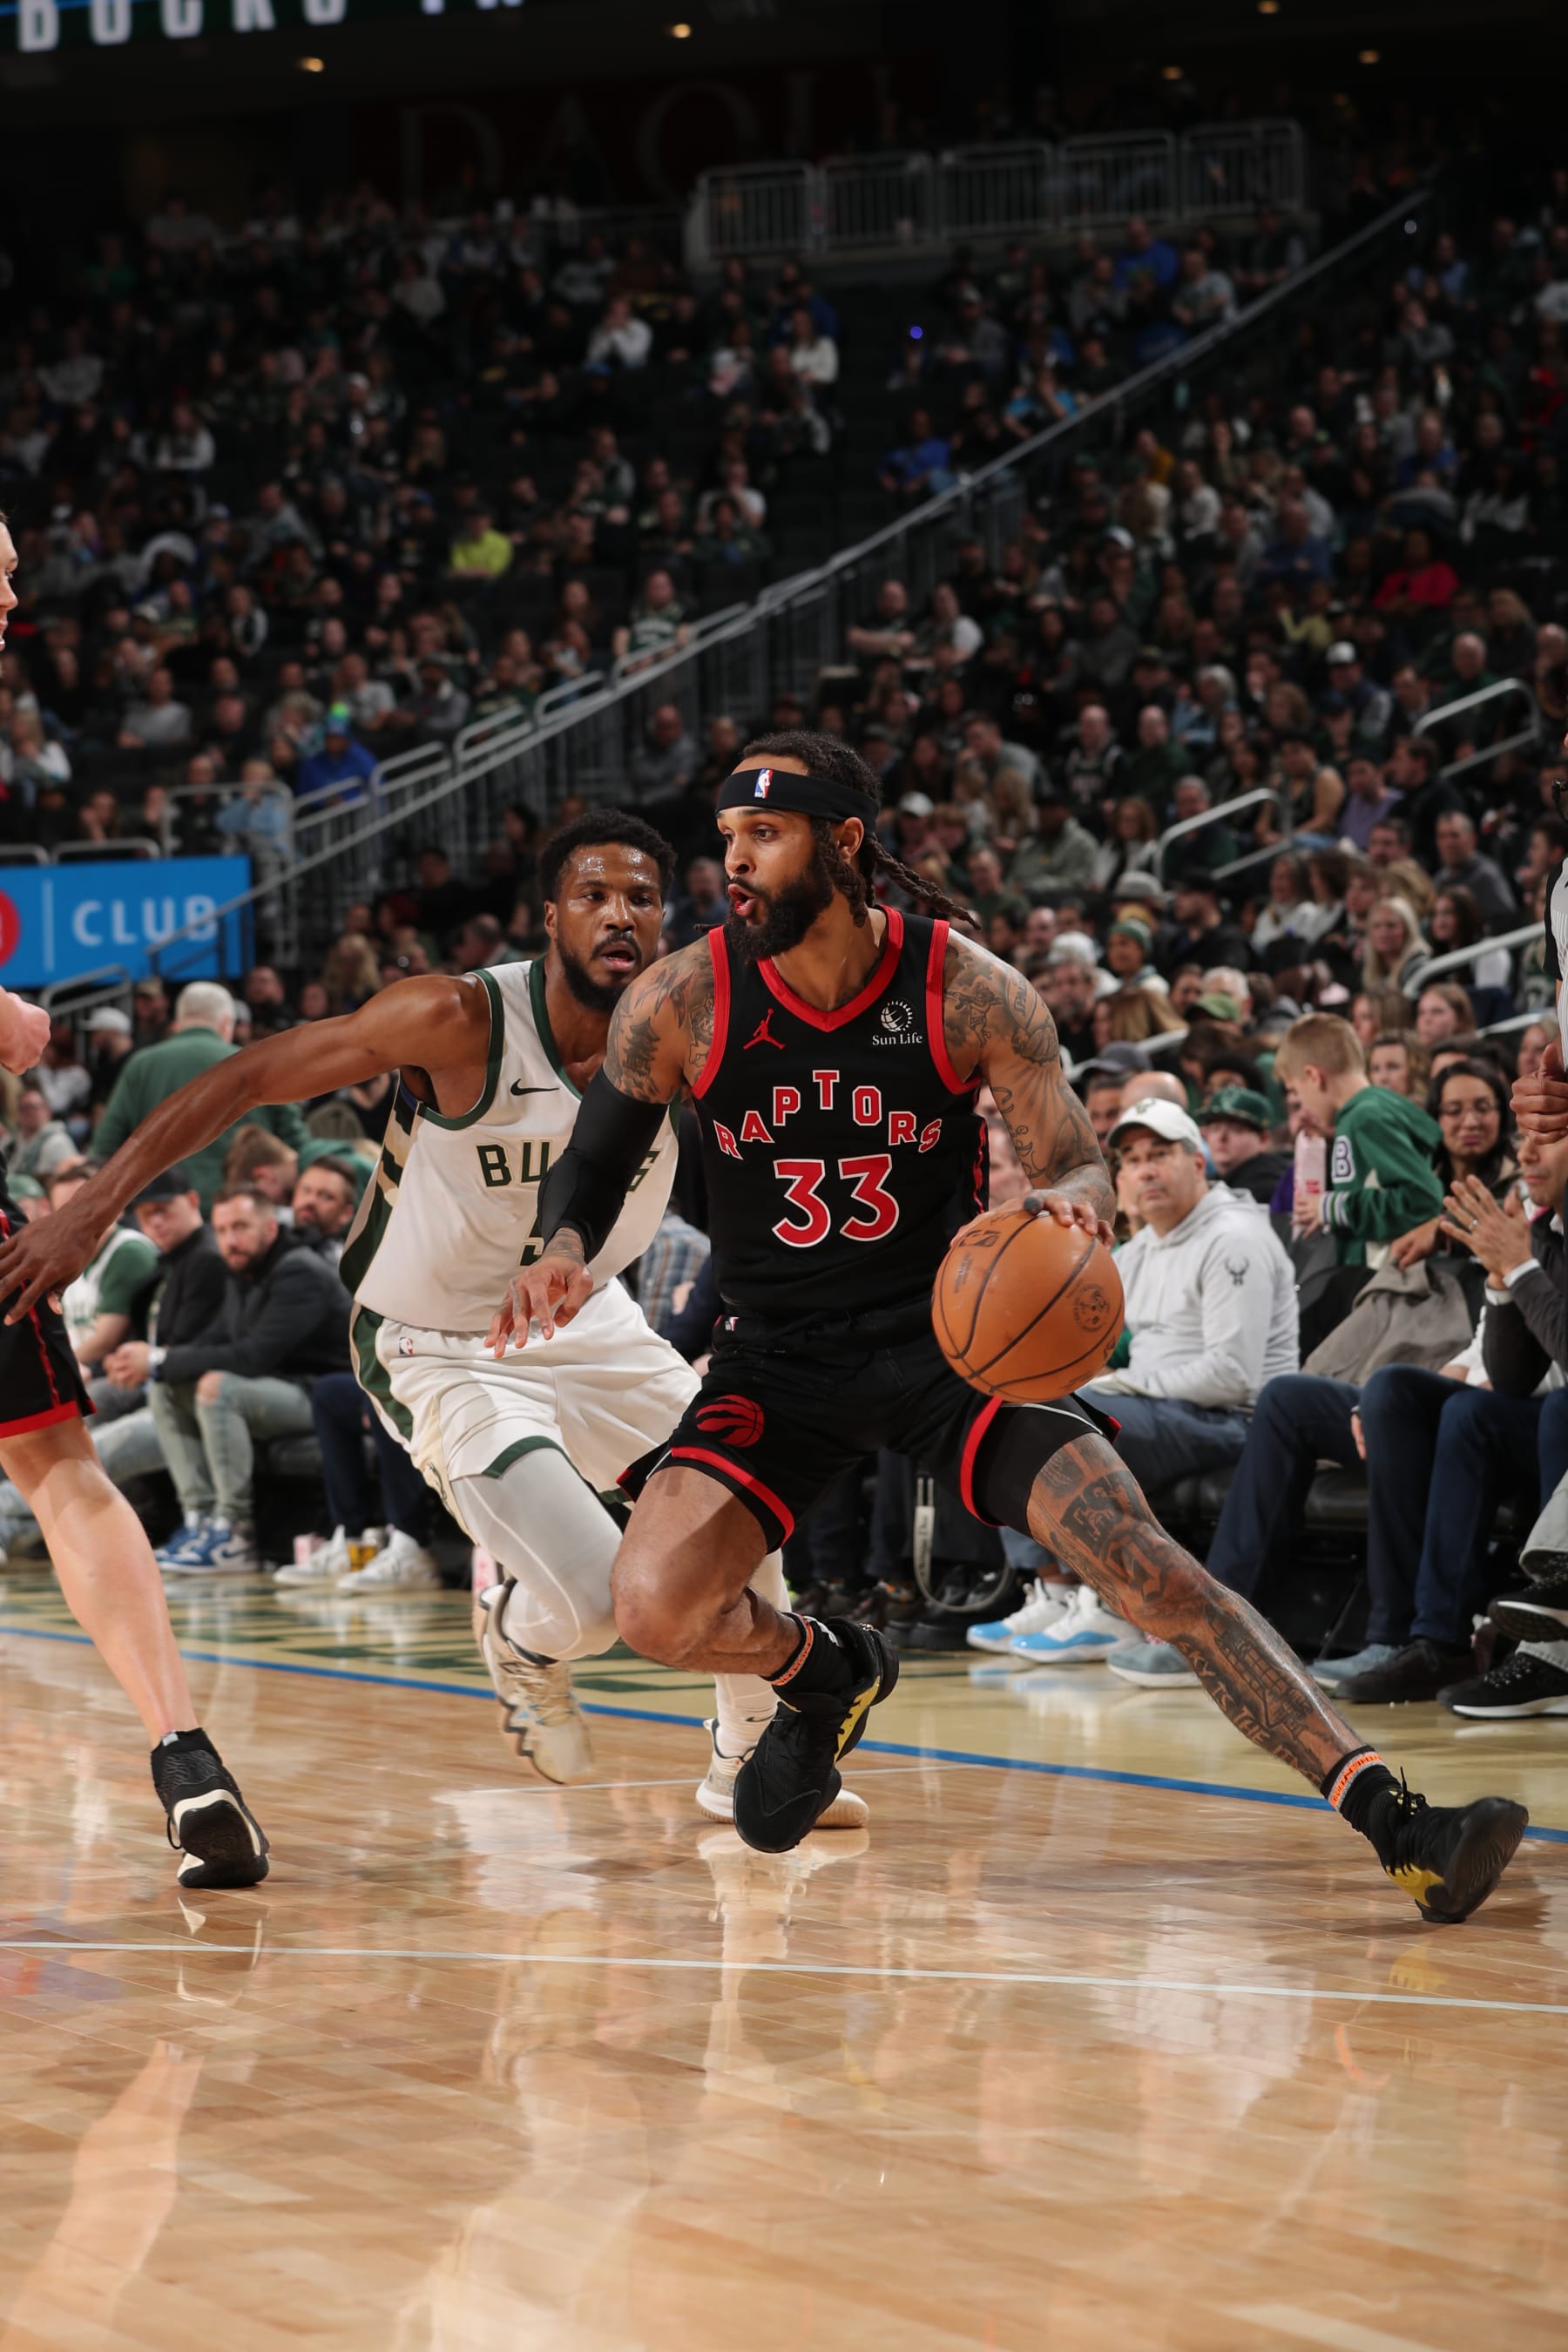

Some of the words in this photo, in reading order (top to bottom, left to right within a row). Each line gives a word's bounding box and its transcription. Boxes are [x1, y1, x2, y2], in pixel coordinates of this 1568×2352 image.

[73, 894, 219, 947] CLUB
[872, 1035, 896, 1045] Sun
[900, 1032, 923, 1044] Life
[713, 1070, 943, 1160] RAPTORS
[476, 1139, 663, 1193] BUS
[1331, 1135, 1356, 1184] B
[772, 1153, 900, 1247] 33
[1233, 1703, 1271, 1744] THE
